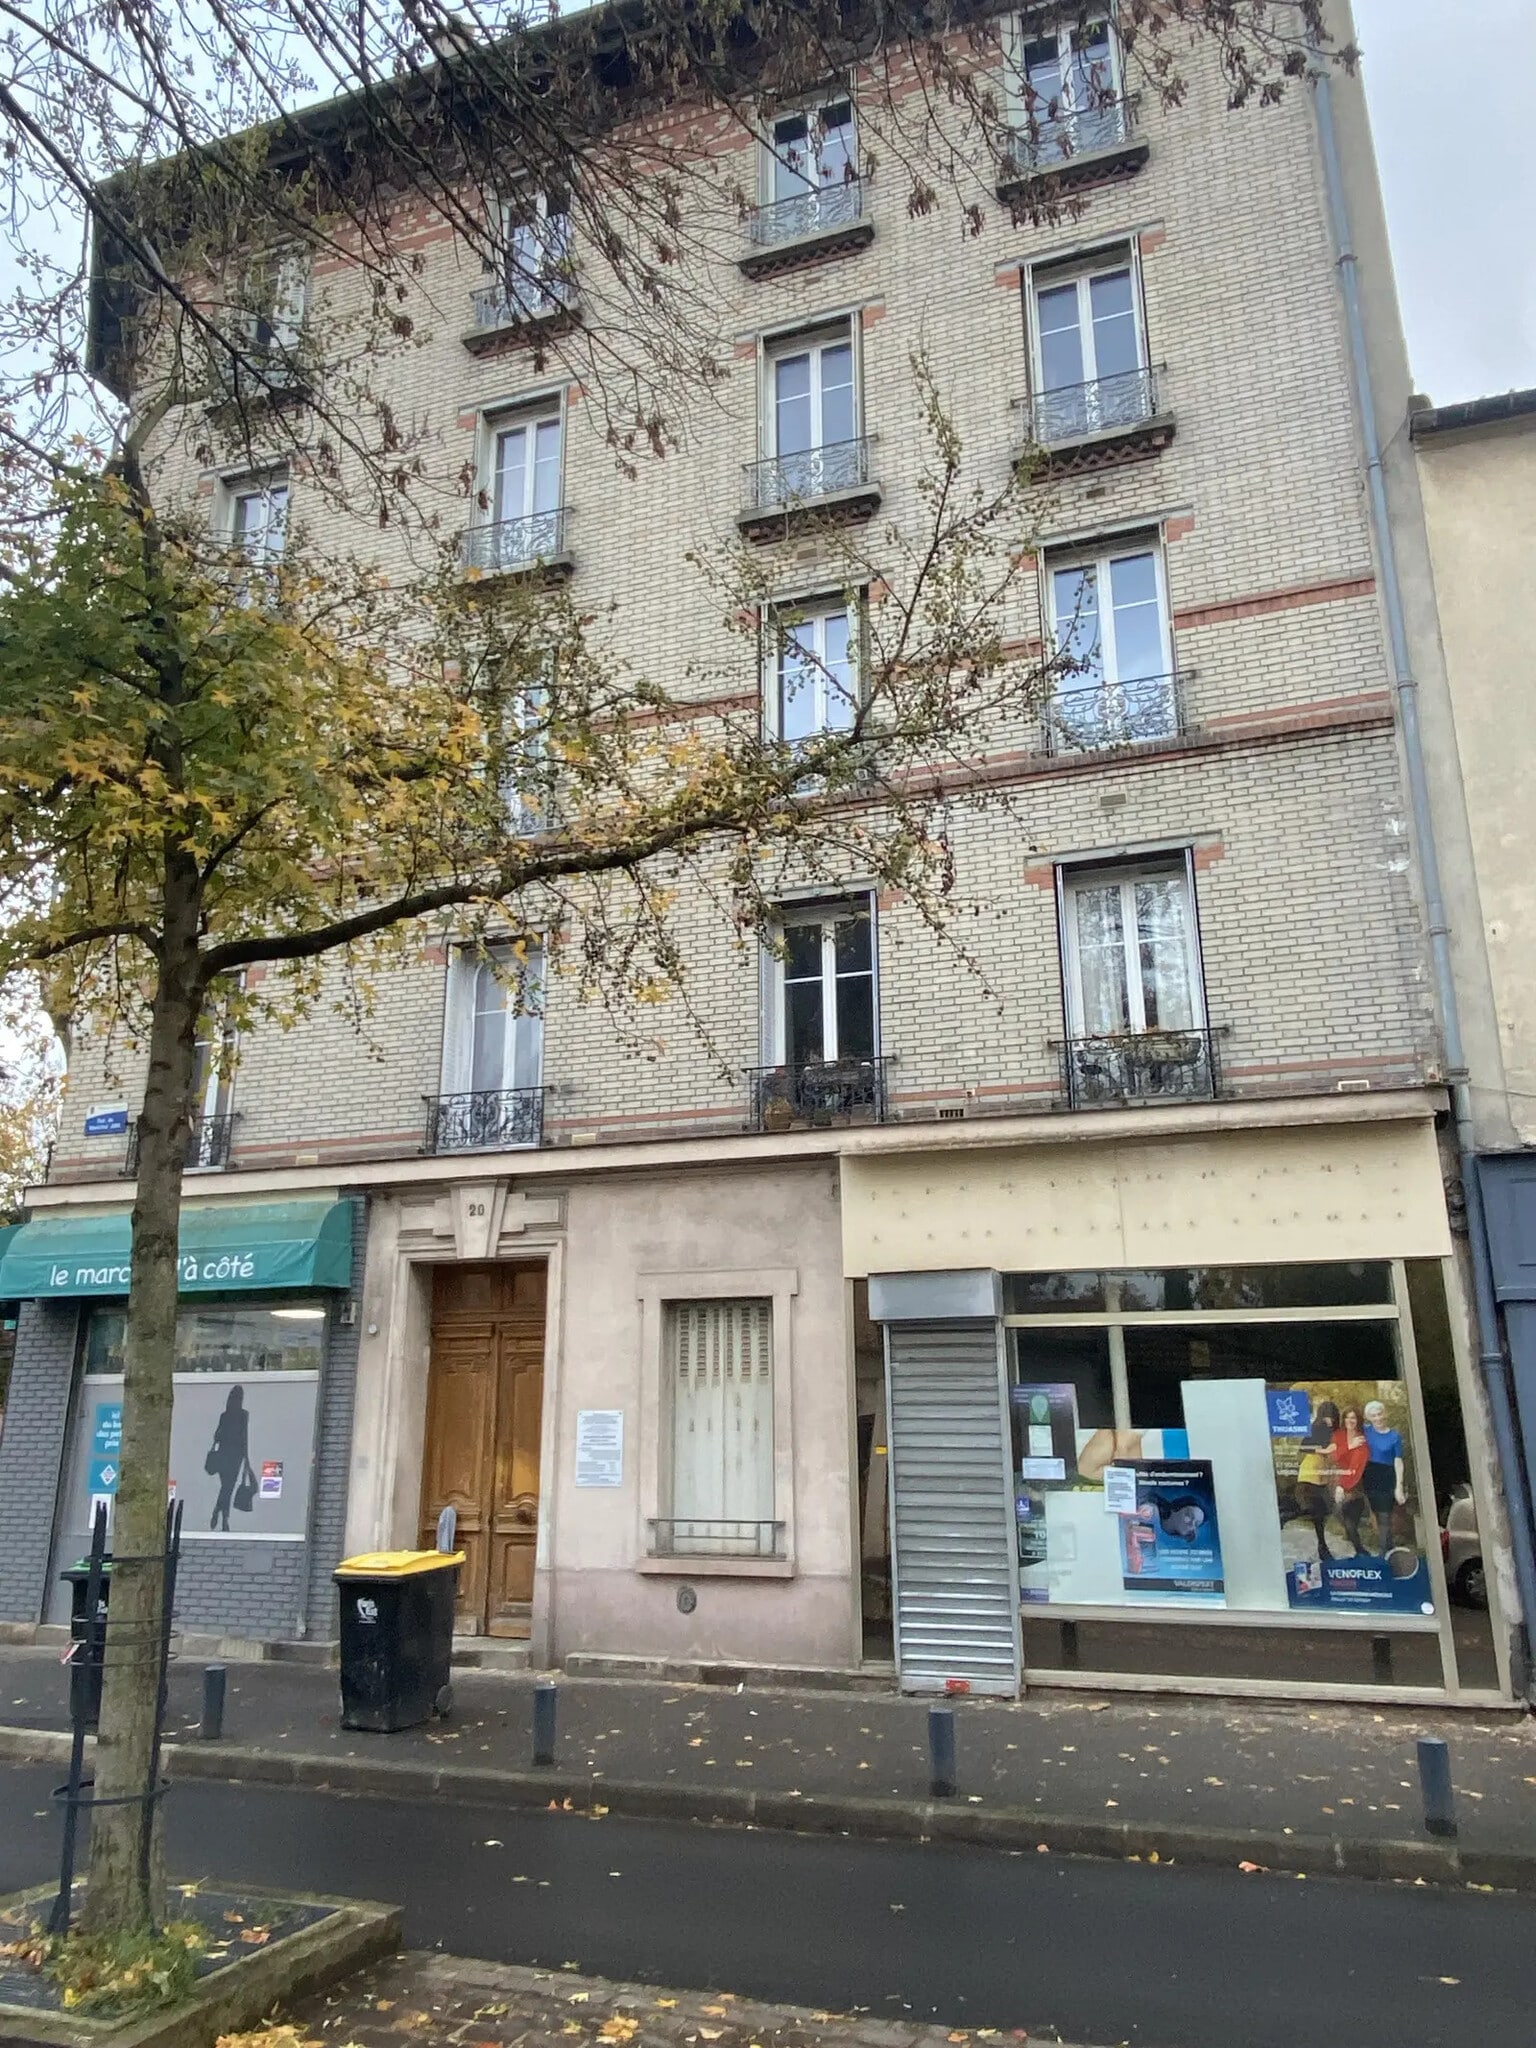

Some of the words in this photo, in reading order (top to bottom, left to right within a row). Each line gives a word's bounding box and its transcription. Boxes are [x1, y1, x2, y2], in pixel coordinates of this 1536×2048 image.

[469, 1204, 485, 1216] 20
[50, 1265, 68, 1286] le
[75, 1266, 132, 1286] marc
[177, 1256, 198, 1281] 'à
[203, 1252, 254, 1280] côté
[1328, 1569, 1382, 1580] VENOFLEX
